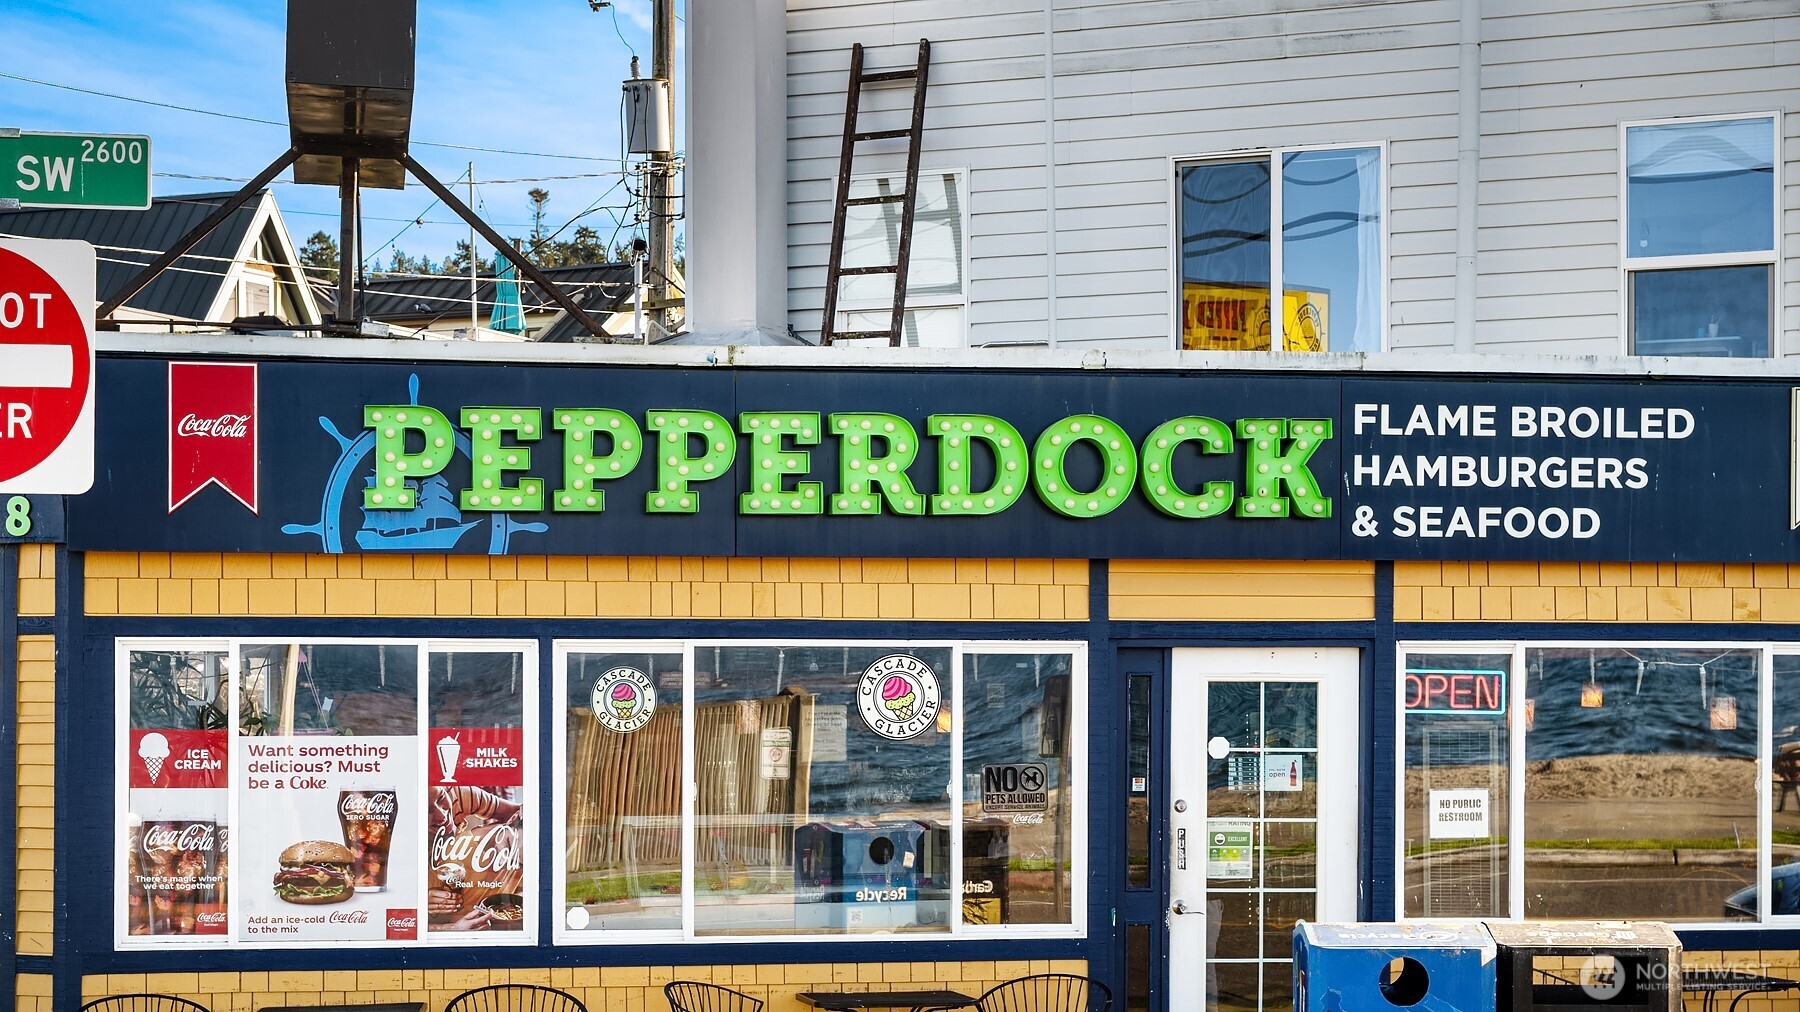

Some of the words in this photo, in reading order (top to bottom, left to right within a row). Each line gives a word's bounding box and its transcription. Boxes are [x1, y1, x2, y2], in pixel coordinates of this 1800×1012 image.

[81, 140, 142, 164] 2600
[16, 155, 75, 192] SW
[177, 413, 252, 438] Coca-Cola
[1354, 403, 1497, 437] FLAME
[1512, 406, 1695, 439] BROILED
[363, 404, 1333, 520] PEPPERDOCK
[1354, 454, 1649, 489] HAMBURGERS
[5, 495, 32, 537] 8
[1351, 505, 1380, 538] &
[1392, 506, 1601, 539] SEAFOOD
[596, 669, 651, 693] CASCADE
[861, 658, 927, 696] CASCADE
[1405, 674, 1499, 709] OPEN
[598, 710, 652, 730] GLACIER
[874, 700, 937, 736] GLACIER
[187, 749, 209, 759] ICE
[248, 744, 294, 757] Want
[299, 743, 389, 758] something
[476, 747, 508, 757] MILK
[174, 759, 221, 770] CREAM
[248, 760, 333, 773] delicious?
[338, 760, 381, 773] Must
[466, 758, 518, 768] SHAKES
[248, 777, 270, 789] be
[274, 779, 285, 789] a
[289, 776, 327, 790] Coke
[985, 766, 1018, 792] NO
[341, 793, 395, 815] Coca-Cola
[985, 793, 1006, 804] PETS
[1007, 792, 1045, 804] ALLOWED
[1439, 799, 1451, 809] NO
[1452, 798, 1482, 809] PUBLIC
[1439, 812, 1483, 822] RESTROOM
[143, 824, 215, 852] Coca-Cola
[135, 875, 168, 883] There's
[170, 875, 197, 883] magic
[455, 880, 474, 888] Real
[477, 880, 502, 888] Magic
[247, 915, 268, 924] Add
[286, 915, 325, 924] ice-cold
[328, 910, 370, 924] Coca-Cola
[247, 926, 258, 934] to
[261, 925, 278, 934] the
[280, 925, 299, 933] mix
